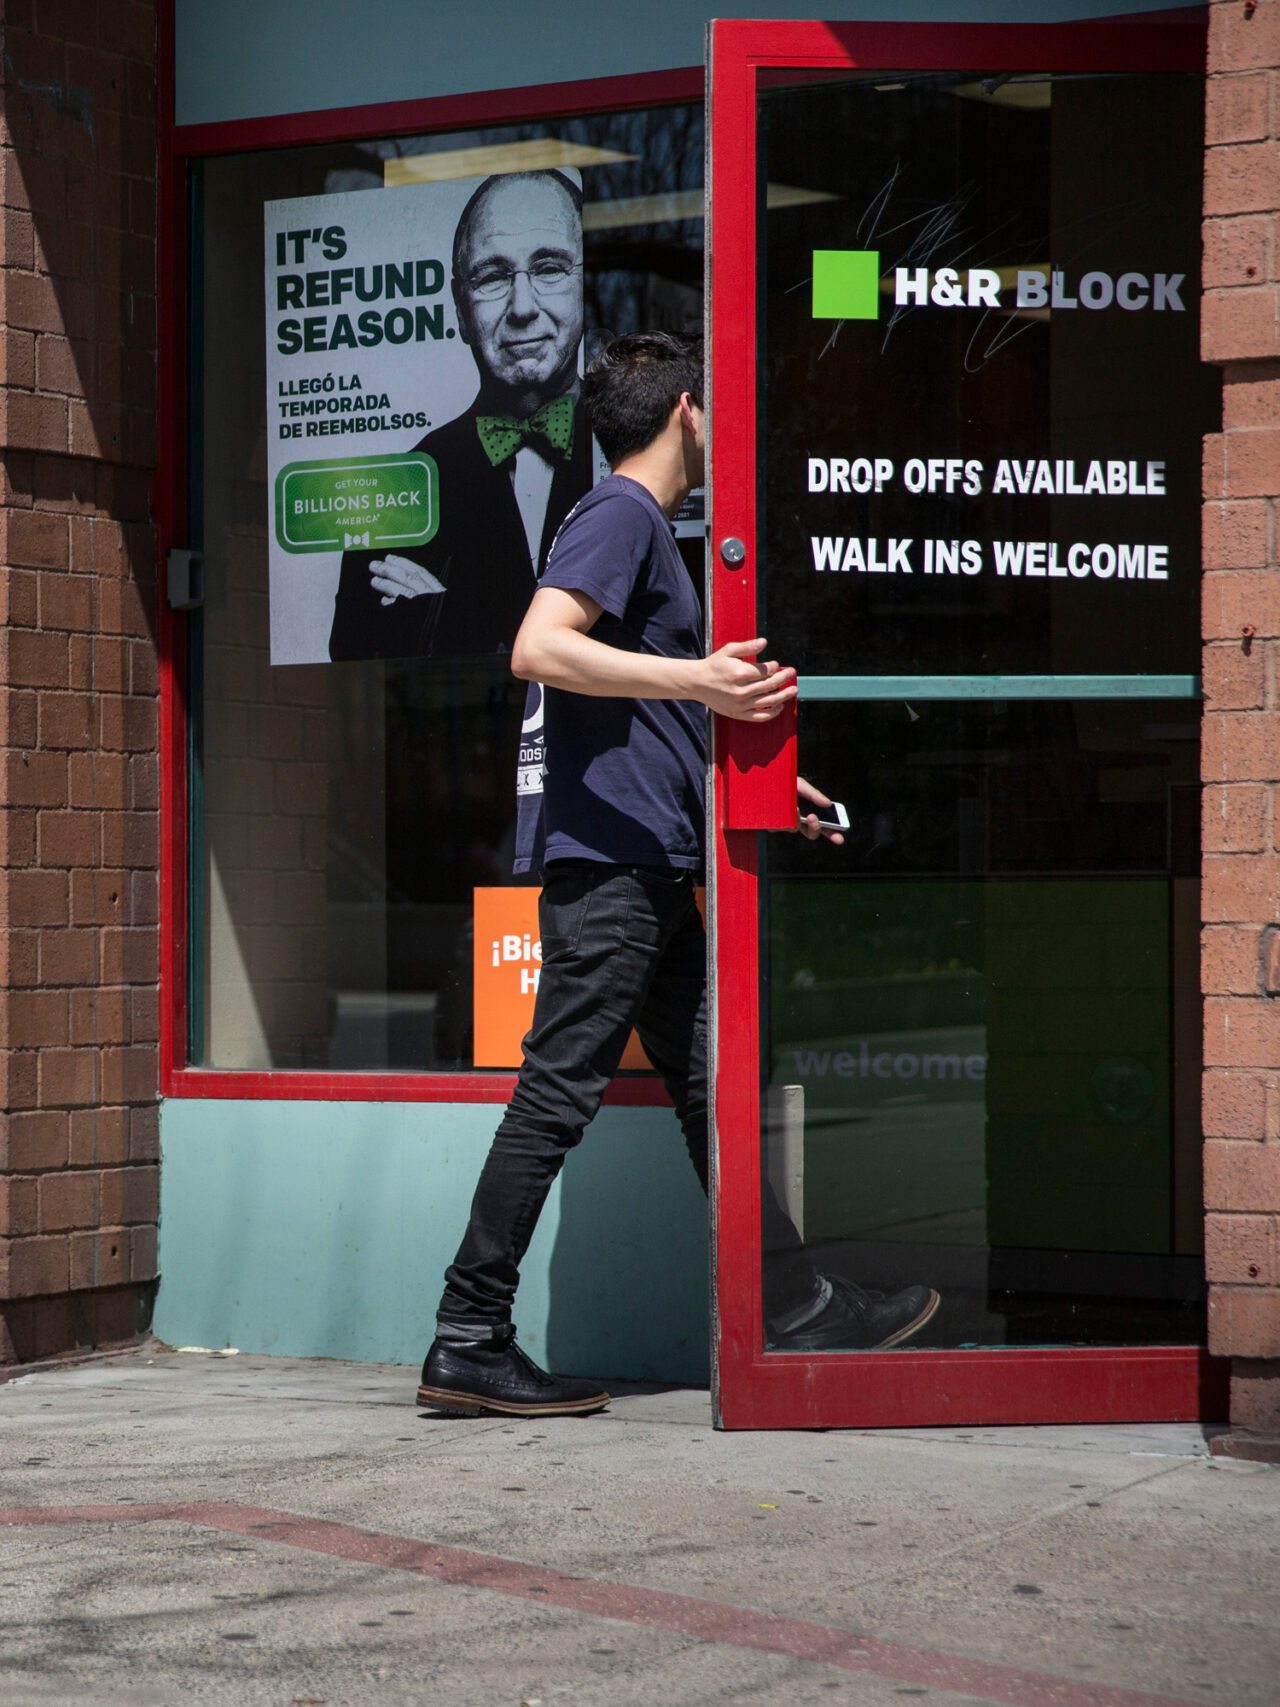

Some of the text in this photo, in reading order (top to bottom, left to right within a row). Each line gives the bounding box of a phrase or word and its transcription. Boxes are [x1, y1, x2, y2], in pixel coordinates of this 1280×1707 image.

[276, 225, 348, 266] IT'S
[277, 259, 445, 311] REFUND
[895, 267, 1187, 311] H&R BLOCK
[277, 304, 456, 355] SEASON.
[278, 372, 362, 397] LLEGÓ LA
[278, 393, 391, 418] TEMPORADA
[279, 411, 432, 440] DE REEMBOLSOS.
[334, 478, 379, 490] GET YOUR
[807, 457, 1167, 496] DROP OFFS AVAILABLE
[294, 490, 421, 514] BILLIONS BACK
[810, 536, 1170, 580] WALK INS WELCOME
[794, 1042, 988, 1080] welcome
